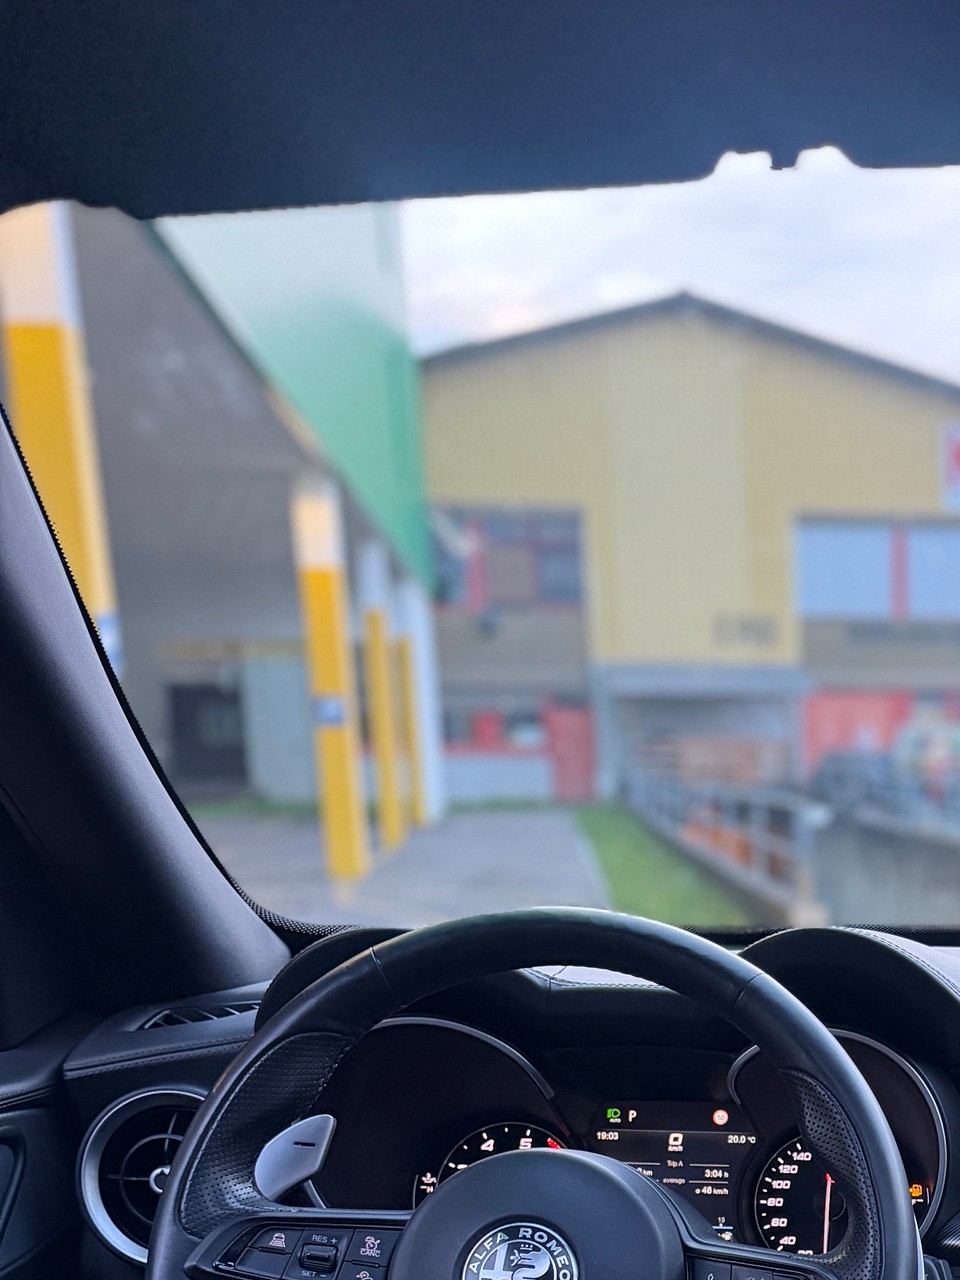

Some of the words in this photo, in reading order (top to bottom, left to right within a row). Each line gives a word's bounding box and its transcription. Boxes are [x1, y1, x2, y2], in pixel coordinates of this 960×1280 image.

[628, 1110, 637, 1122] P
[596, 1131, 619, 1141] 19:03
[668, 1133, 684, 1146] 0
[727, 1134, 746, 1144] 20.0
[480, 1139, 495, 1152] 4
[519, 1137, 533, 1150] 5
[791, 1152, 812, 1161] 140
[667, 1160, 678, 1168] Trip
[704, 1169, 722, 1178] 3:04
[778, 1165, 799, 1174] 120
[771, 1180, 791, 1189] 100
[767, 1198, 784, 1207] 80
[770, 1218, 788, 1227] 60
[312, 1234, 328, 1244] RES
[779, 1236, 797, 1245] 40
[360, 1248, 381, 1258] CANC
[469, 1231, 510, 1274] ALFA
[301, 1269, 317, 1277] SET
